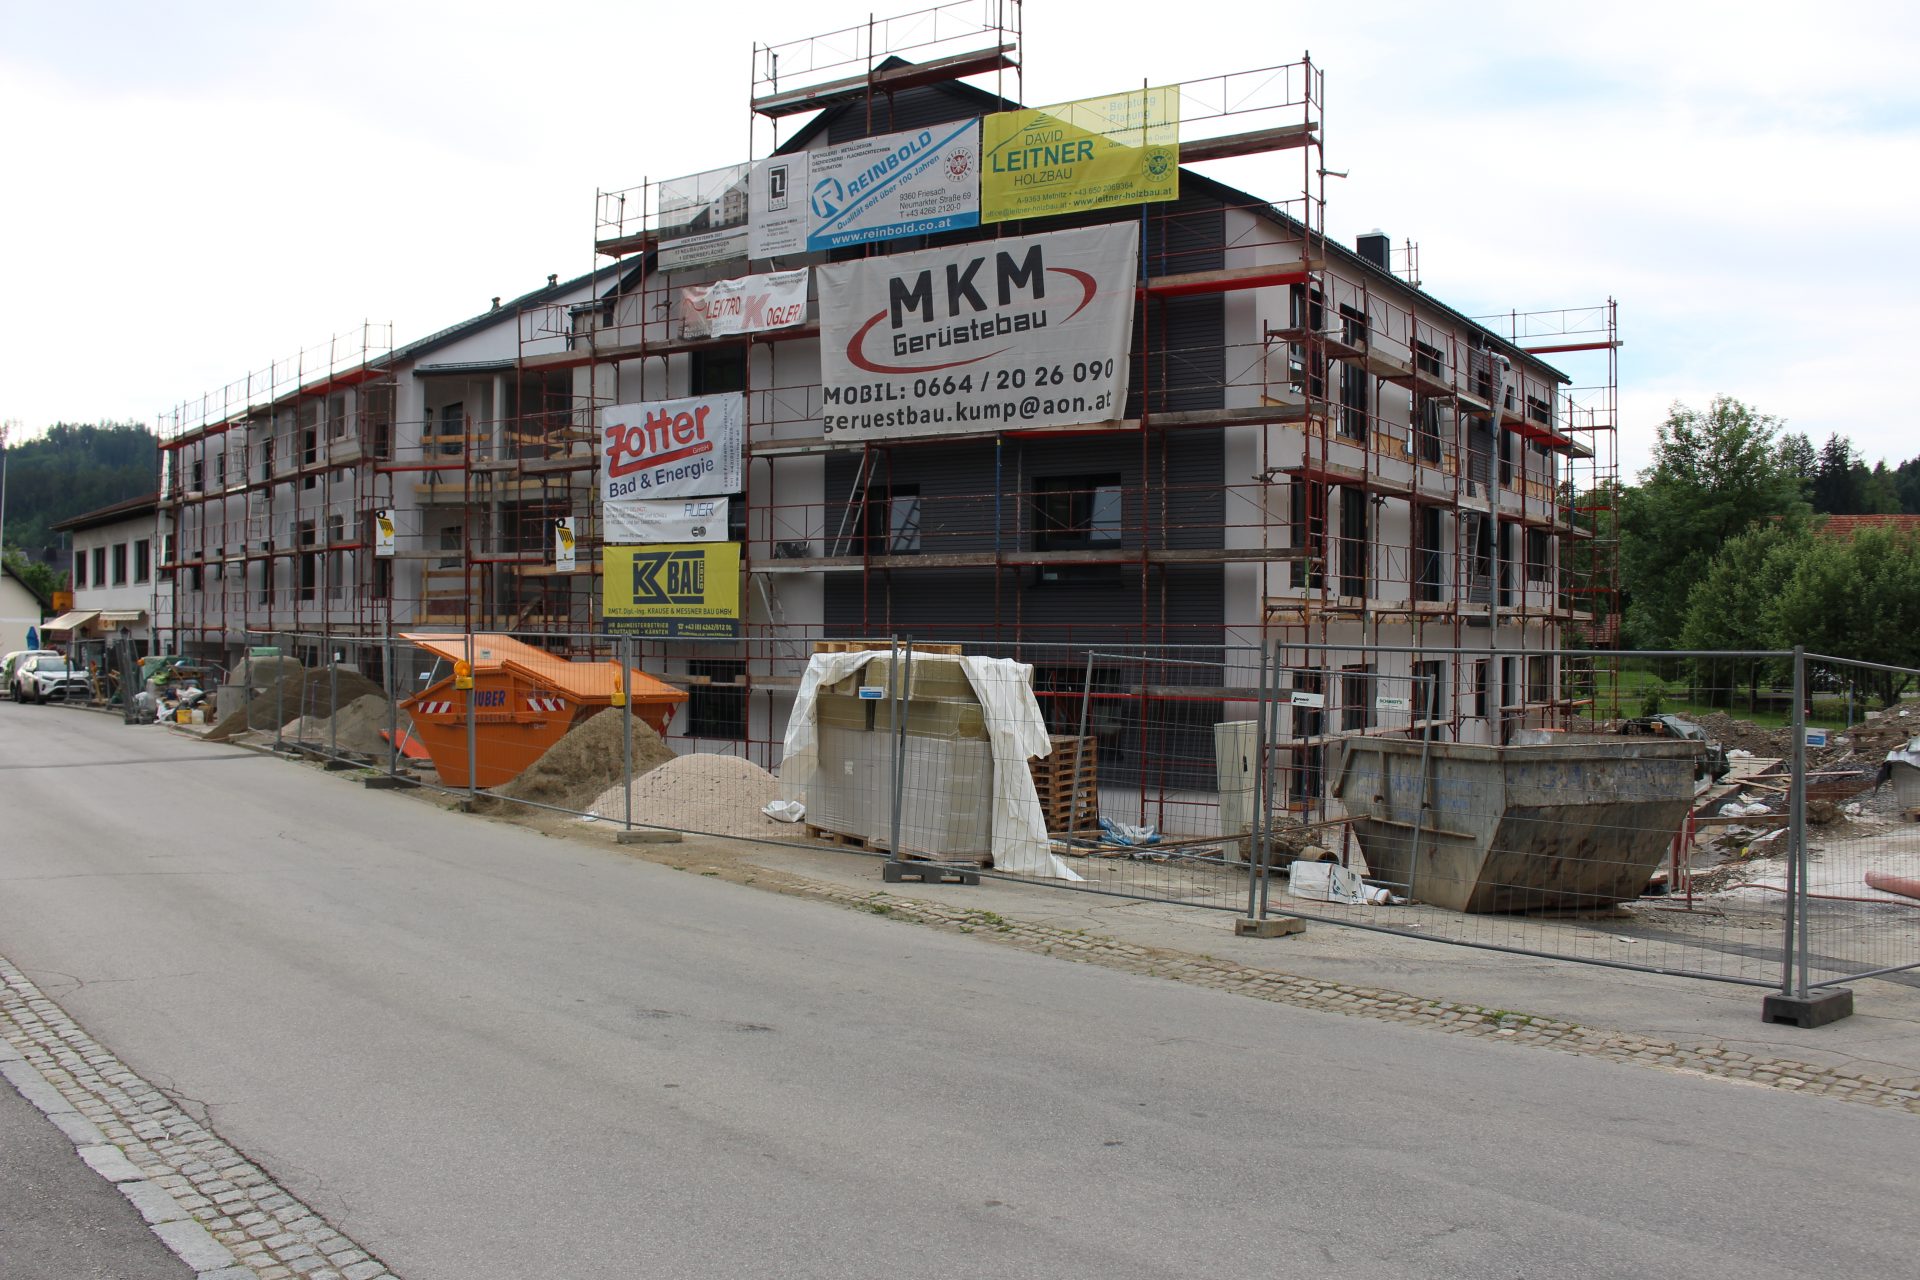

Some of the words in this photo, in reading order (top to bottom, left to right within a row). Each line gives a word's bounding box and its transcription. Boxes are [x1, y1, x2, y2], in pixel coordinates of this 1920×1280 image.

[1109, 95, 1156, 111] Beratung
[1109, 109, 1152, 122] Planung
[1025, 130, 1063, 146] DAVID
[846, 130, 933, 198] REINBOLD
[992, 140, 1095, 173] LEITNER
[1014, 167, 1073, 186] HOLZBAU
[836, 205, 864, 230] Qualität
[864, 195, 878, 211] seit
[880, 185, 897, 199] über
[899, 174, 913, 187] 100
[914, 155, 940, 176] Jahren
[899, 192, 917, 202] 9360
[917, 187, 946, 199] Friesach
[899, 198, 937, 210] Neumarkter
[939, 193, 961, 204] Straße
[962, 191, 972, 200] 69
[1042, 191, 1067, 202] Metnitz
[1088, 186, 1102, 194] 650
[1073, 187, 1172, 207] www.leitner-holzbau.at
[906, 208, 919, 217] +43
[919, 206, 937, 215] 4268
[937, 202, 961, 213] 2120-0
[831, 217, 952, 245] www.reinbold.co.at
[889, 244, 1045, 330] MKM
[893, 309, 1047, 357] Gerüstebau
[823, 384, 906, 405] MOBIL:
[914, 373, 973, 399] 0664
[980, 371, 990, 392] /
[996, 368, 1026, 391] 20
[1034, 364, 1064, 386] 26
[1072, 358, 1114, 383] 090
[823, 388, 1112, 434] geruestbau.kump@aon.at
[605, 405, 711, 478] Zotter
[692, 444, 709, 454] GmbH
[609, 477, 636, 498] Bad
[640, 473, 652, 489] &
[656, 458, 714, 486] Energie
[647, 607, 670, 615] KRAUSE
[716, 608, 733, 616] GMBH
